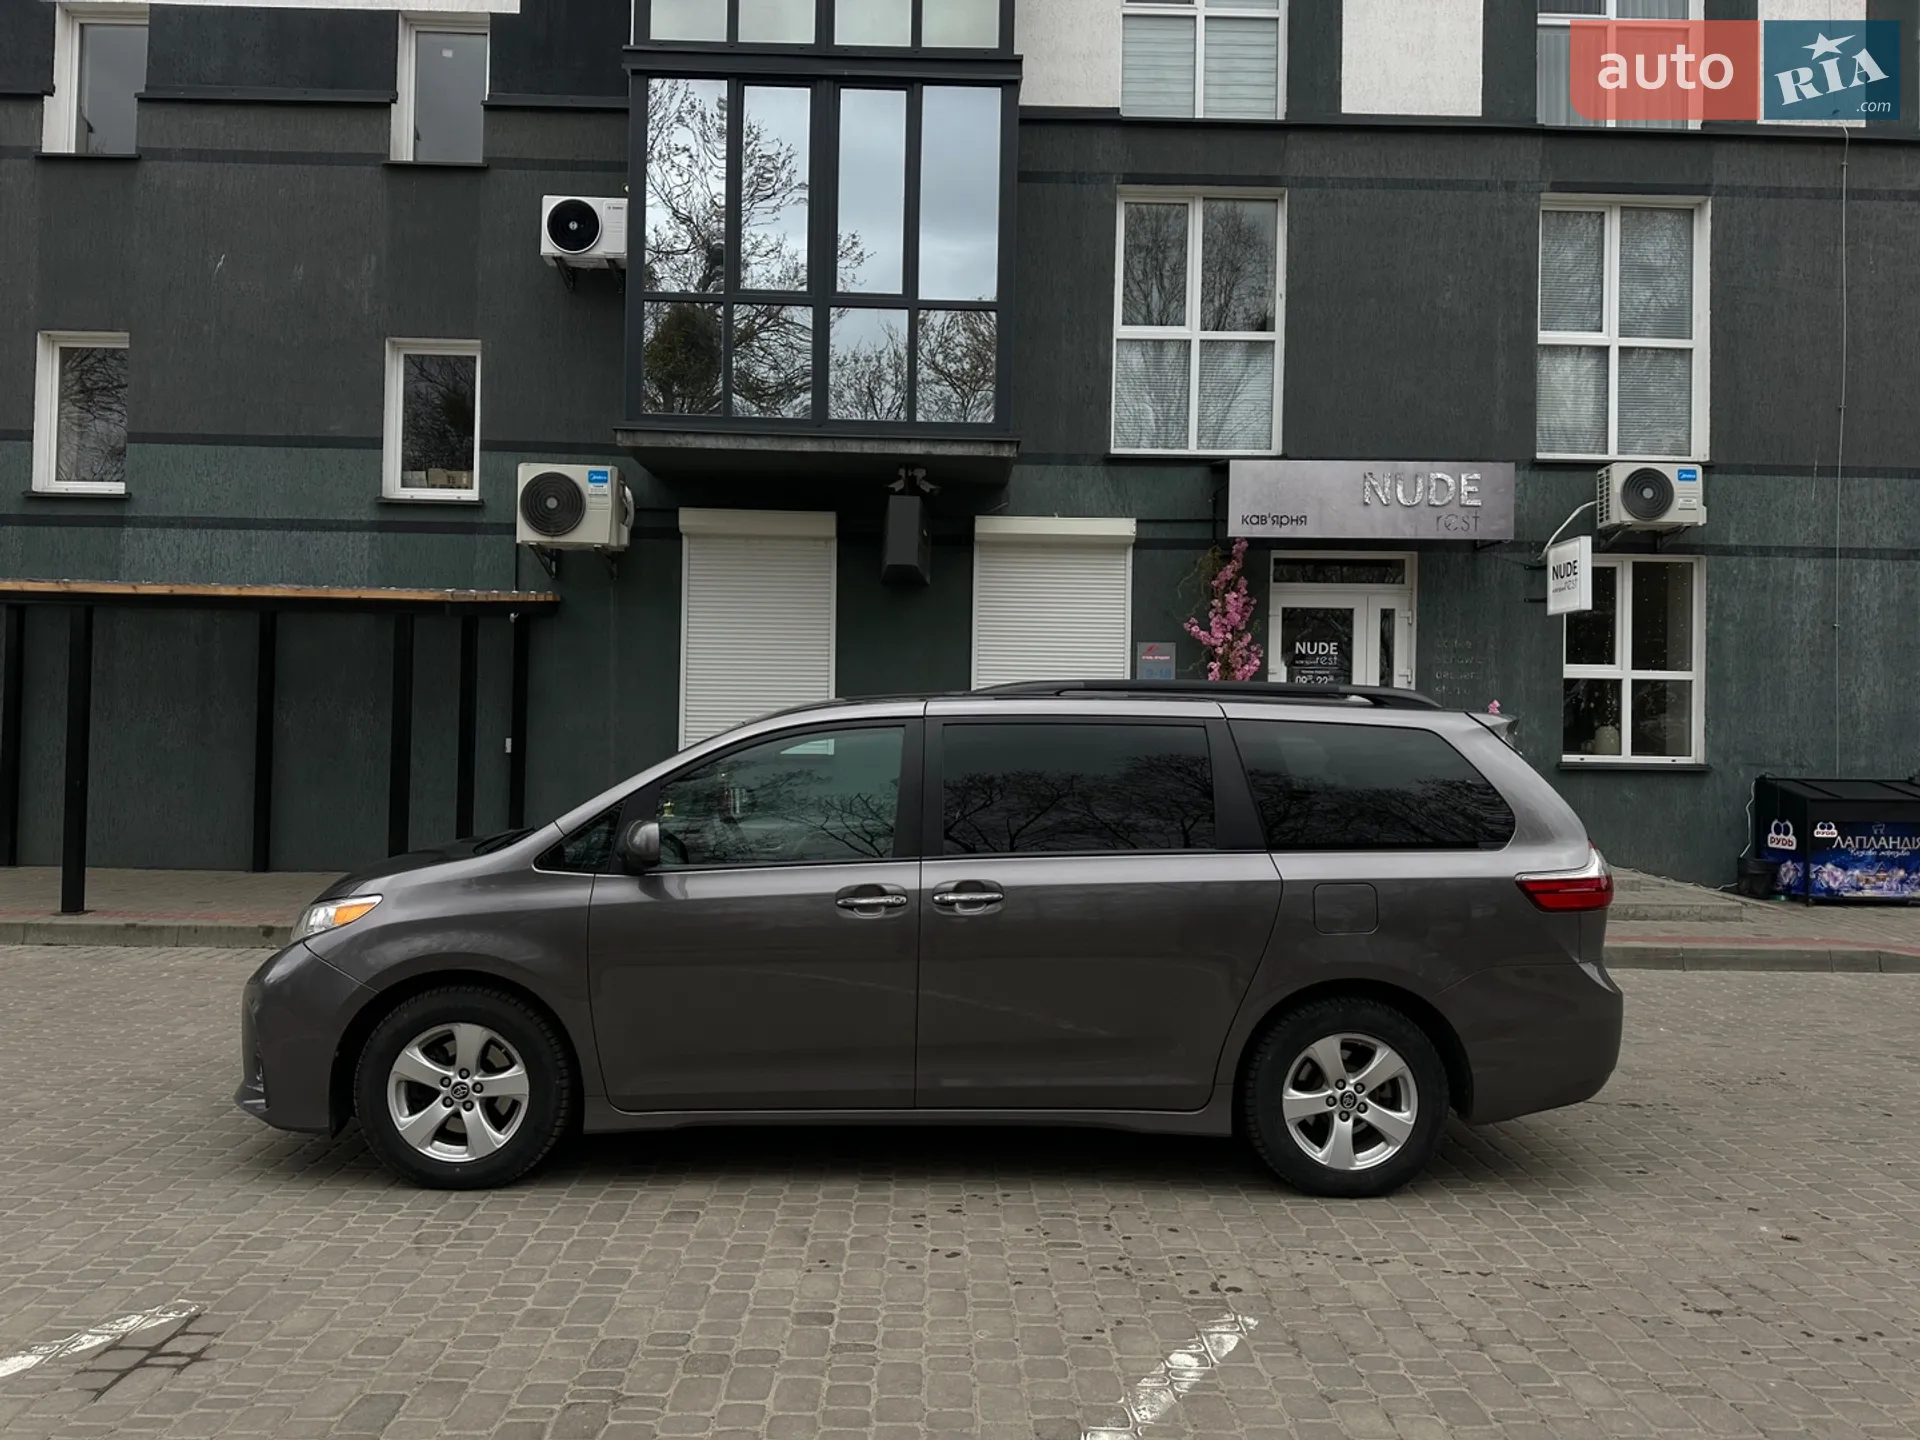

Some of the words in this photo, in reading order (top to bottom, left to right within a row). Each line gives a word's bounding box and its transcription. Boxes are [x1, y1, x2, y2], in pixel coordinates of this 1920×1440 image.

[1363, 471, 1483, 508] NUDE
[1241, 511, 1308, 528] кав'ярня
[1435, 510, 1480, 533] rest
[1552, 560, 1578, 581] NUDE
[1295, 641, 1339, 655] NUDE
[1316, 655, 1339, 666] rest
